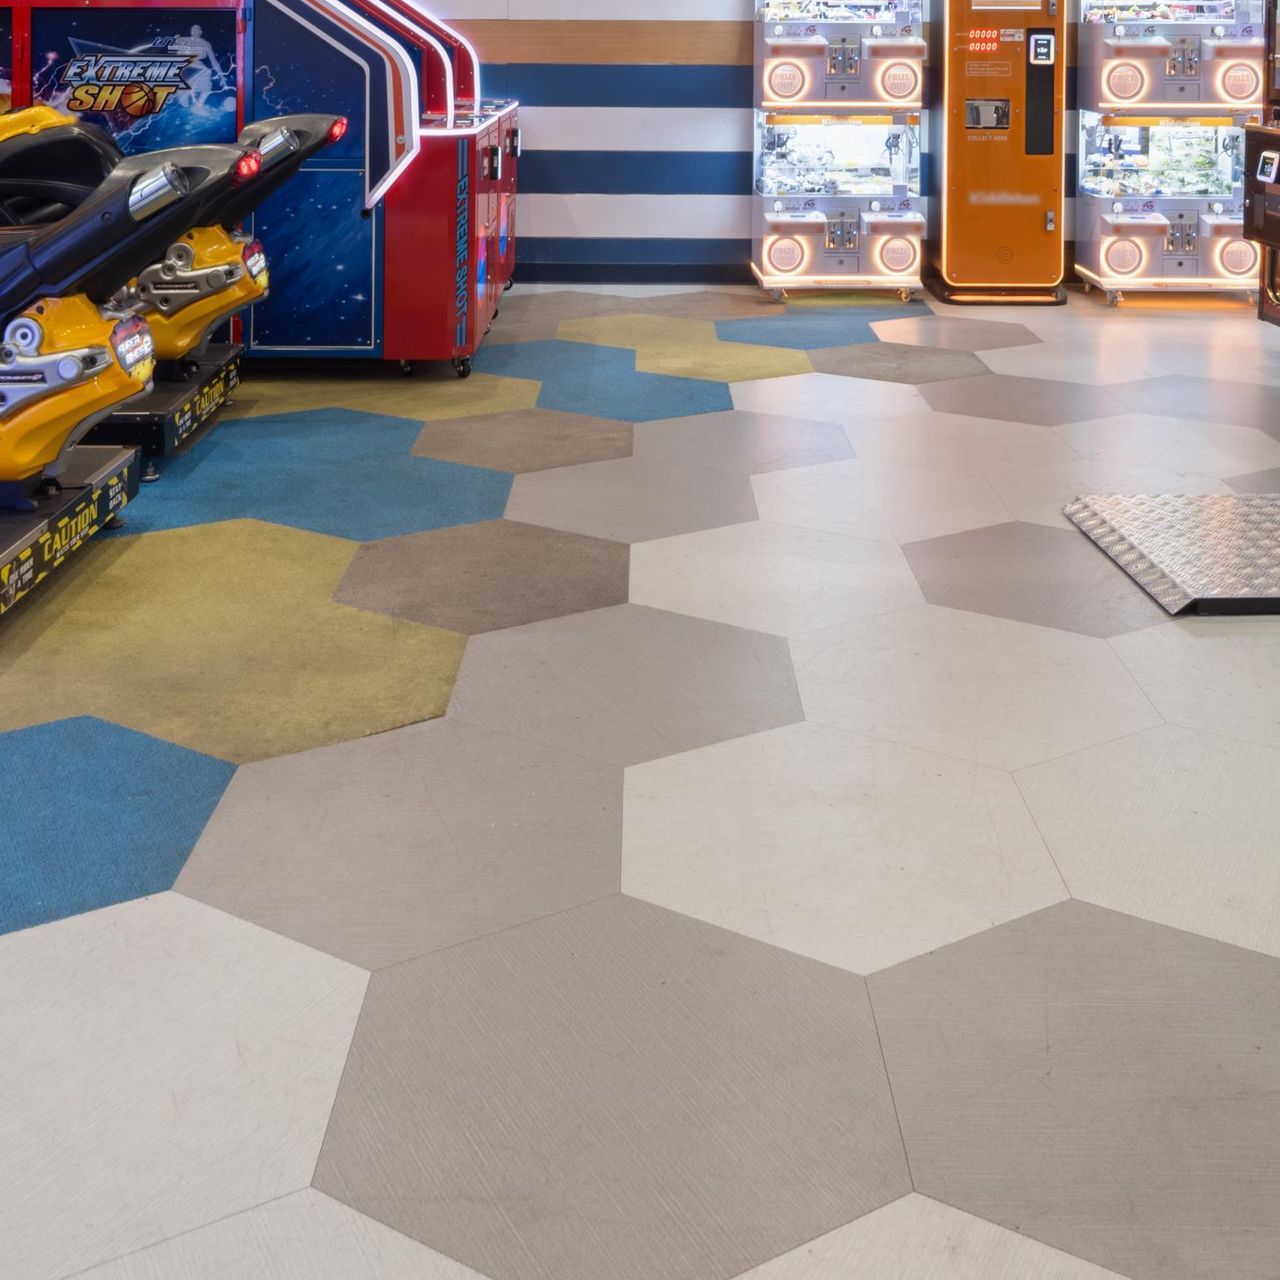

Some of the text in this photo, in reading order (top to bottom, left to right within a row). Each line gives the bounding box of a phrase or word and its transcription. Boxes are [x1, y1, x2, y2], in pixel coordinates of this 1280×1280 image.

[969, 30, 997, 38] 00000
[969, 43, 997, 51] 00000
[65, 55, 190, 82] EXTREME
[774, 73, 797, 81] PRIZE
[888, 73, 910, 81] PRIZE
[456, 175, 468, 319] EXTREME SHOT
[109, 483, 122, 500] STAY
[44, 500, 98, 561] CAUTION
